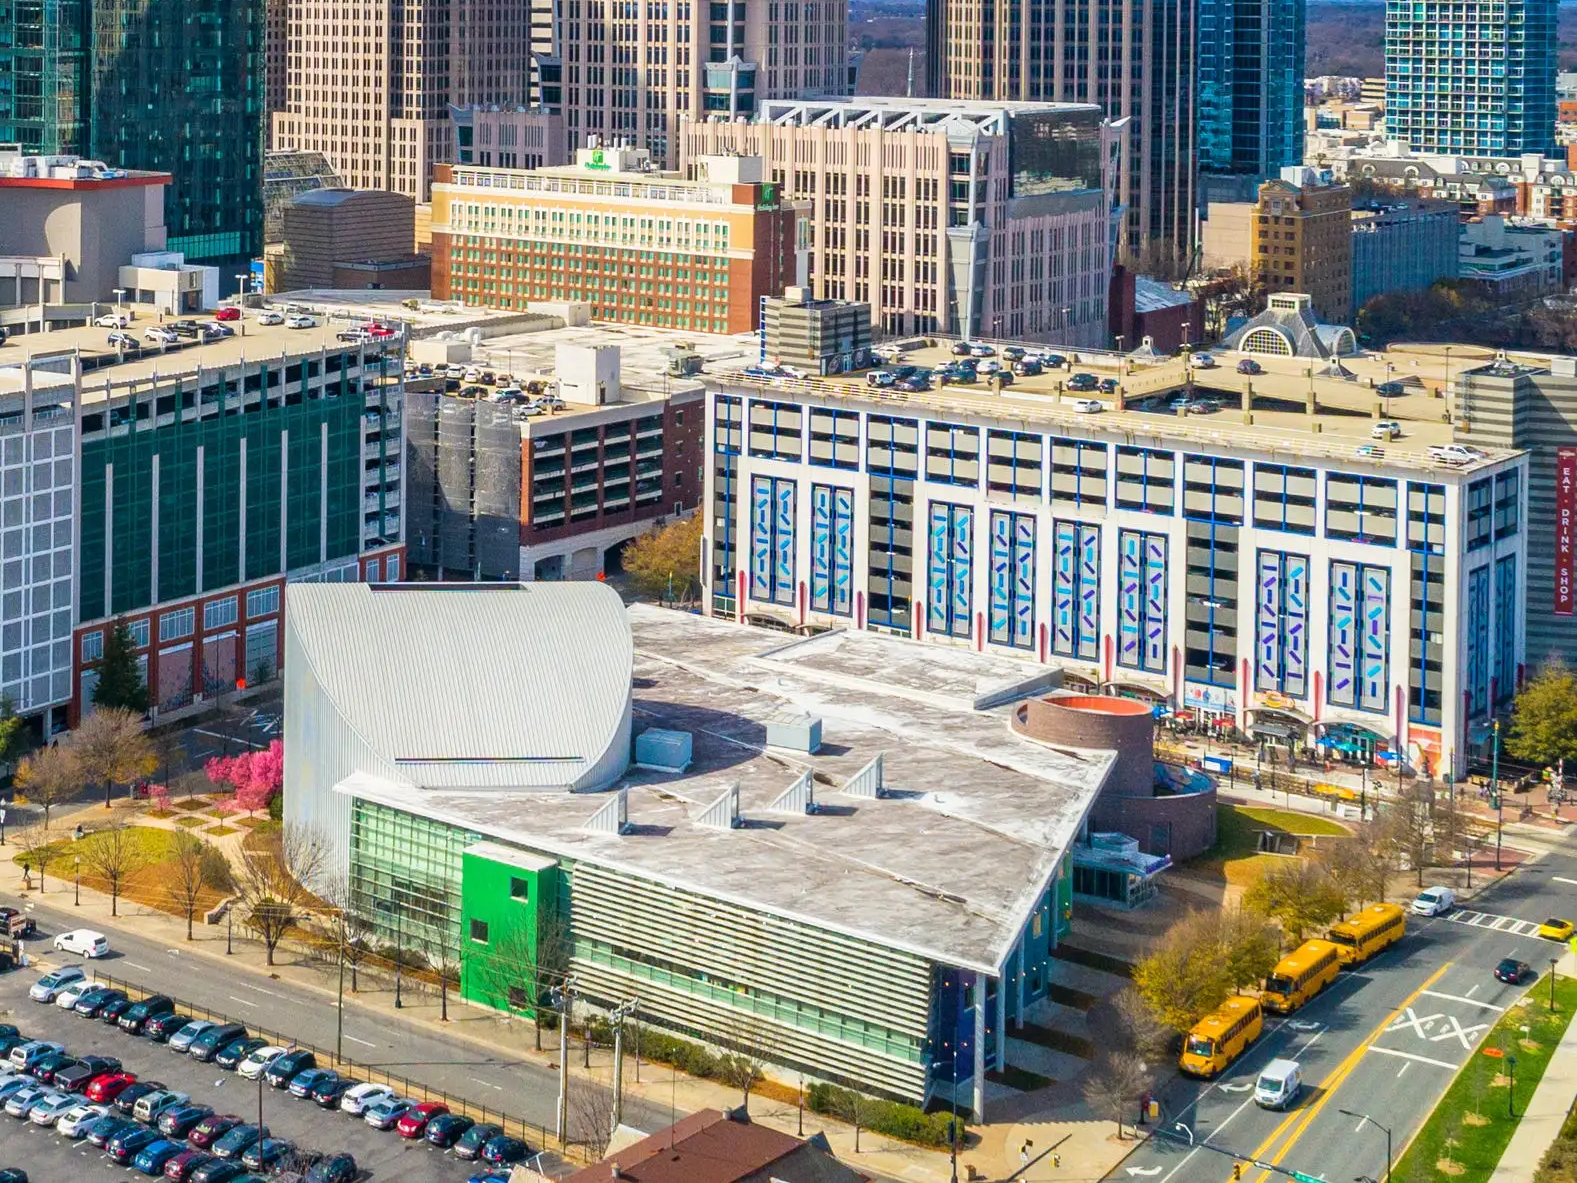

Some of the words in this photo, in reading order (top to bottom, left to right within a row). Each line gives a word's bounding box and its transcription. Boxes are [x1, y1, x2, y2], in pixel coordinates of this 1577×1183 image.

[1562, 468, 1571, 494] EAT
[1561, 509, 1570, 553] DRINK
[1560, 568, 1569, 603] SHOP
